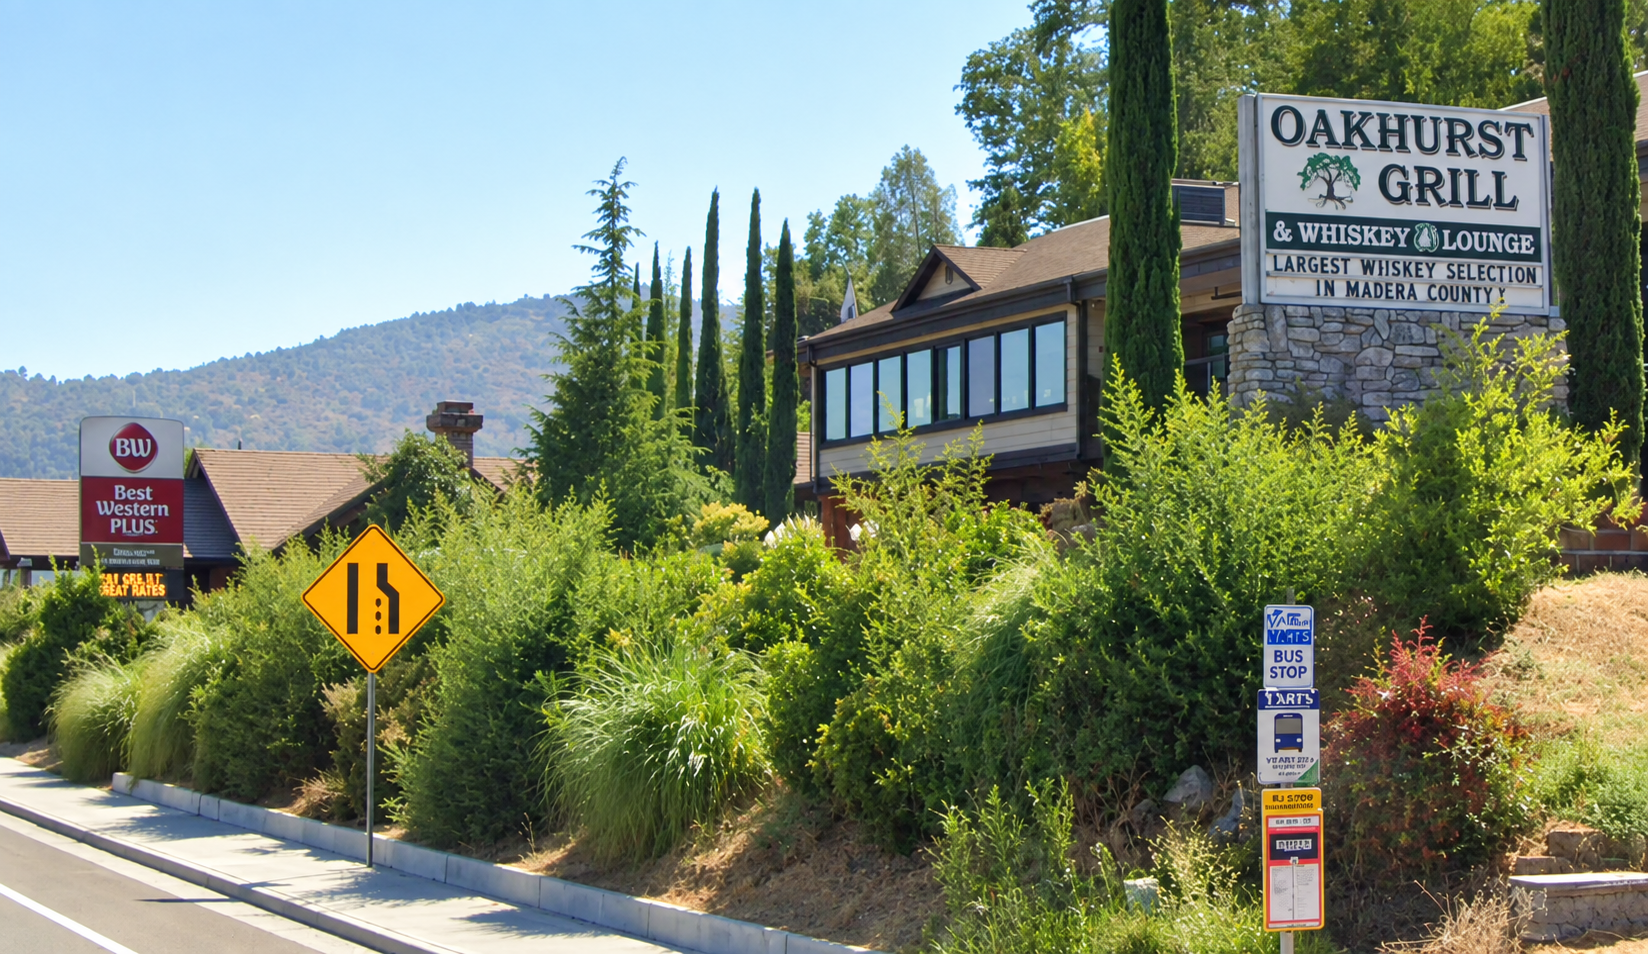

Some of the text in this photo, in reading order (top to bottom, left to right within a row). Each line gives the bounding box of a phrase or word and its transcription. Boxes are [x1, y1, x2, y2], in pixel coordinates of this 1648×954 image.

[1271, 105, 1534, 161] OAKHURST
[1378, 163, 1519, 210] GRILL
[1273, 220, 1535, 254] & WHISKEY LOUNGE
[1273, 254, 1537, 284] LARGEST WHISKEY SELECTION
[1315, 279, 1335, 297] IN
[1345, 280, 1418, 301] MADERA
[1427, 284, 1493, 304] COUNTY
[115, 438, 152, 458] BW
[114, 484, 153, 501] Best
[96, 500, 169, 517] Western
[131, 584, 166, 597] RATES
[1273, 650, 1303, 663] BUS
[1269, 665, 1308, 679] STOP
